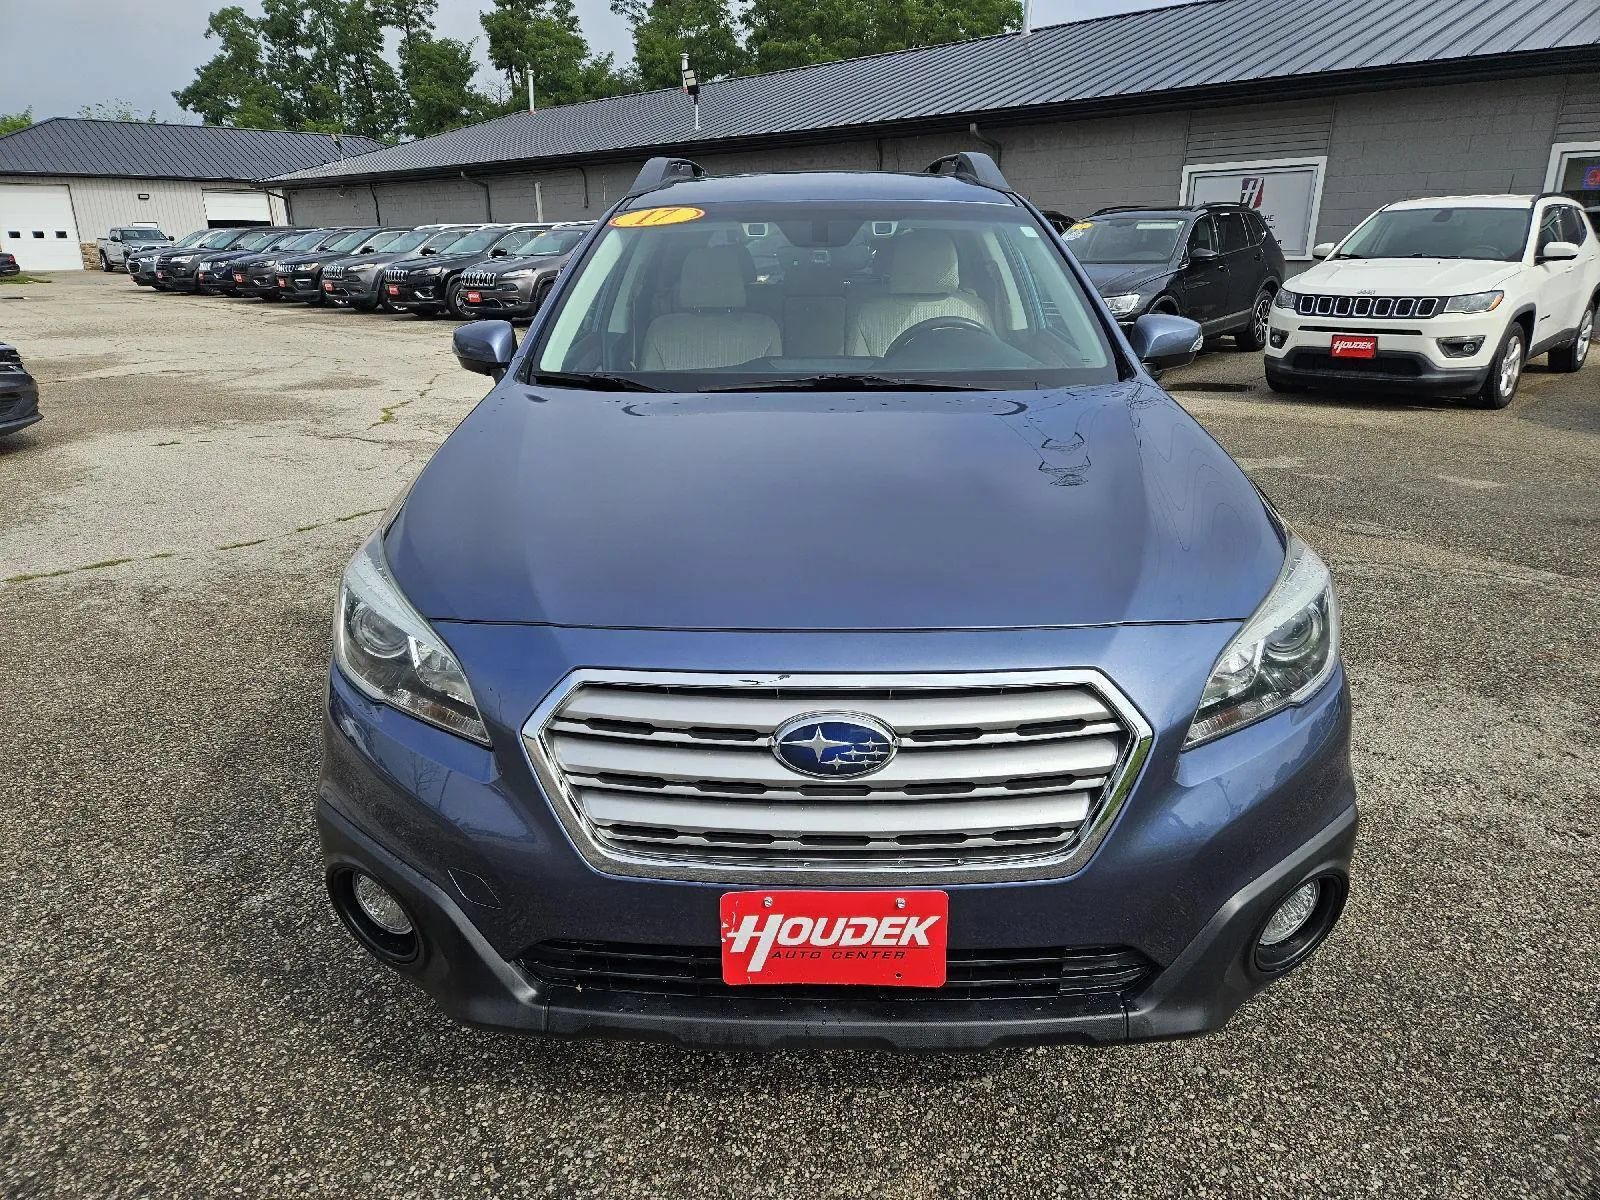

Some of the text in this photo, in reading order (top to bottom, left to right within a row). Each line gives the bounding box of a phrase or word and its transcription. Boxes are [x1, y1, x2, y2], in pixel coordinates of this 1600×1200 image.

[1333, 340, 1375, 354] HOUDEK
[726, 913, 942, 973] HOUDEK
[771, 950, 906, 960] AUTO CENTER
